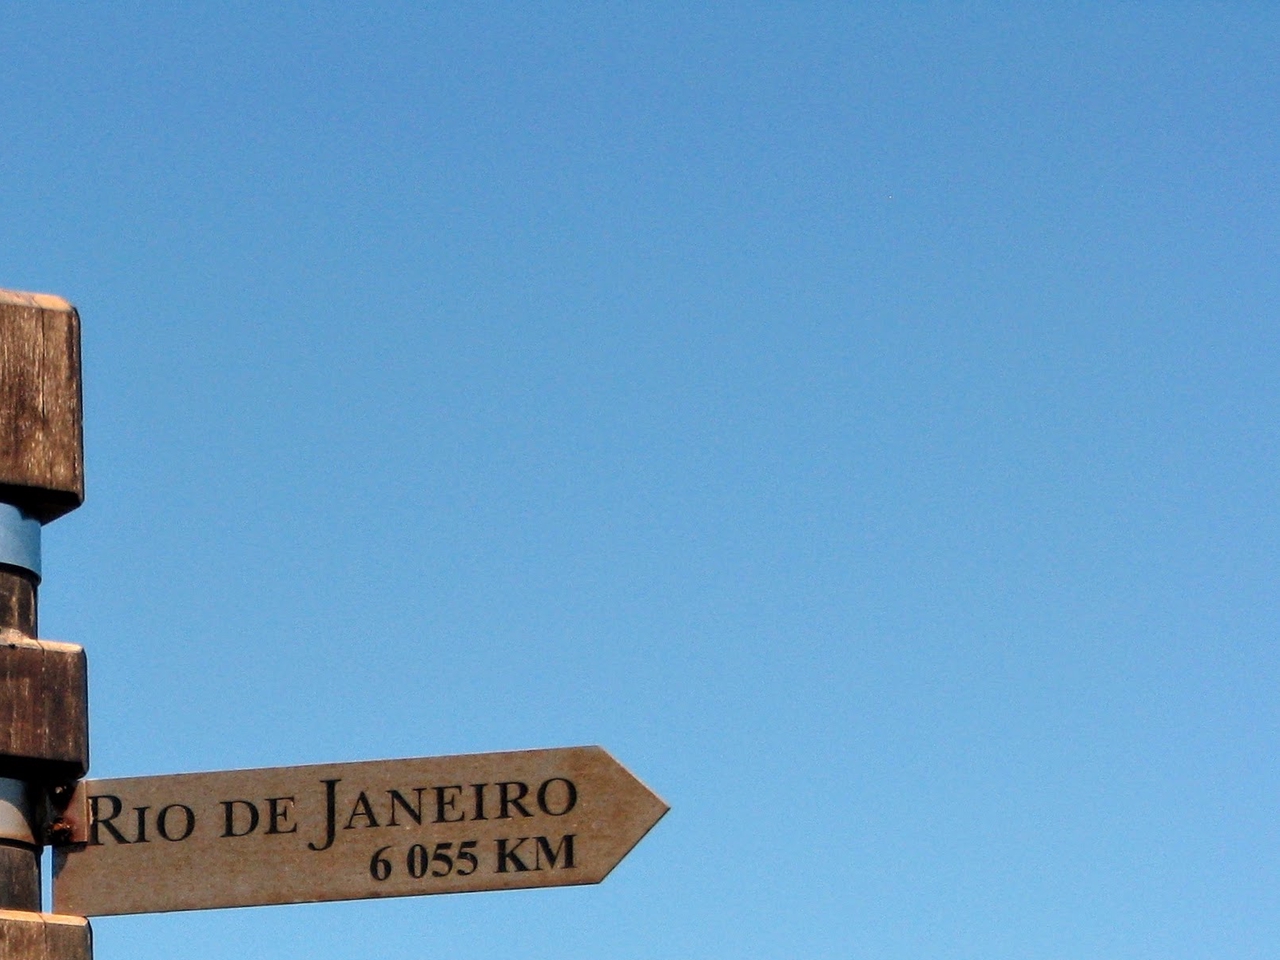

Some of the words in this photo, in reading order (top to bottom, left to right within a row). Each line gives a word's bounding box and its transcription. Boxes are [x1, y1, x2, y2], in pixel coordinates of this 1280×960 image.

[220, 796, 298, 839] DE
[369, 846, 392, 882] 6
[406, 840, 479, 880] 055
[494, 834, 578, 874] KM
